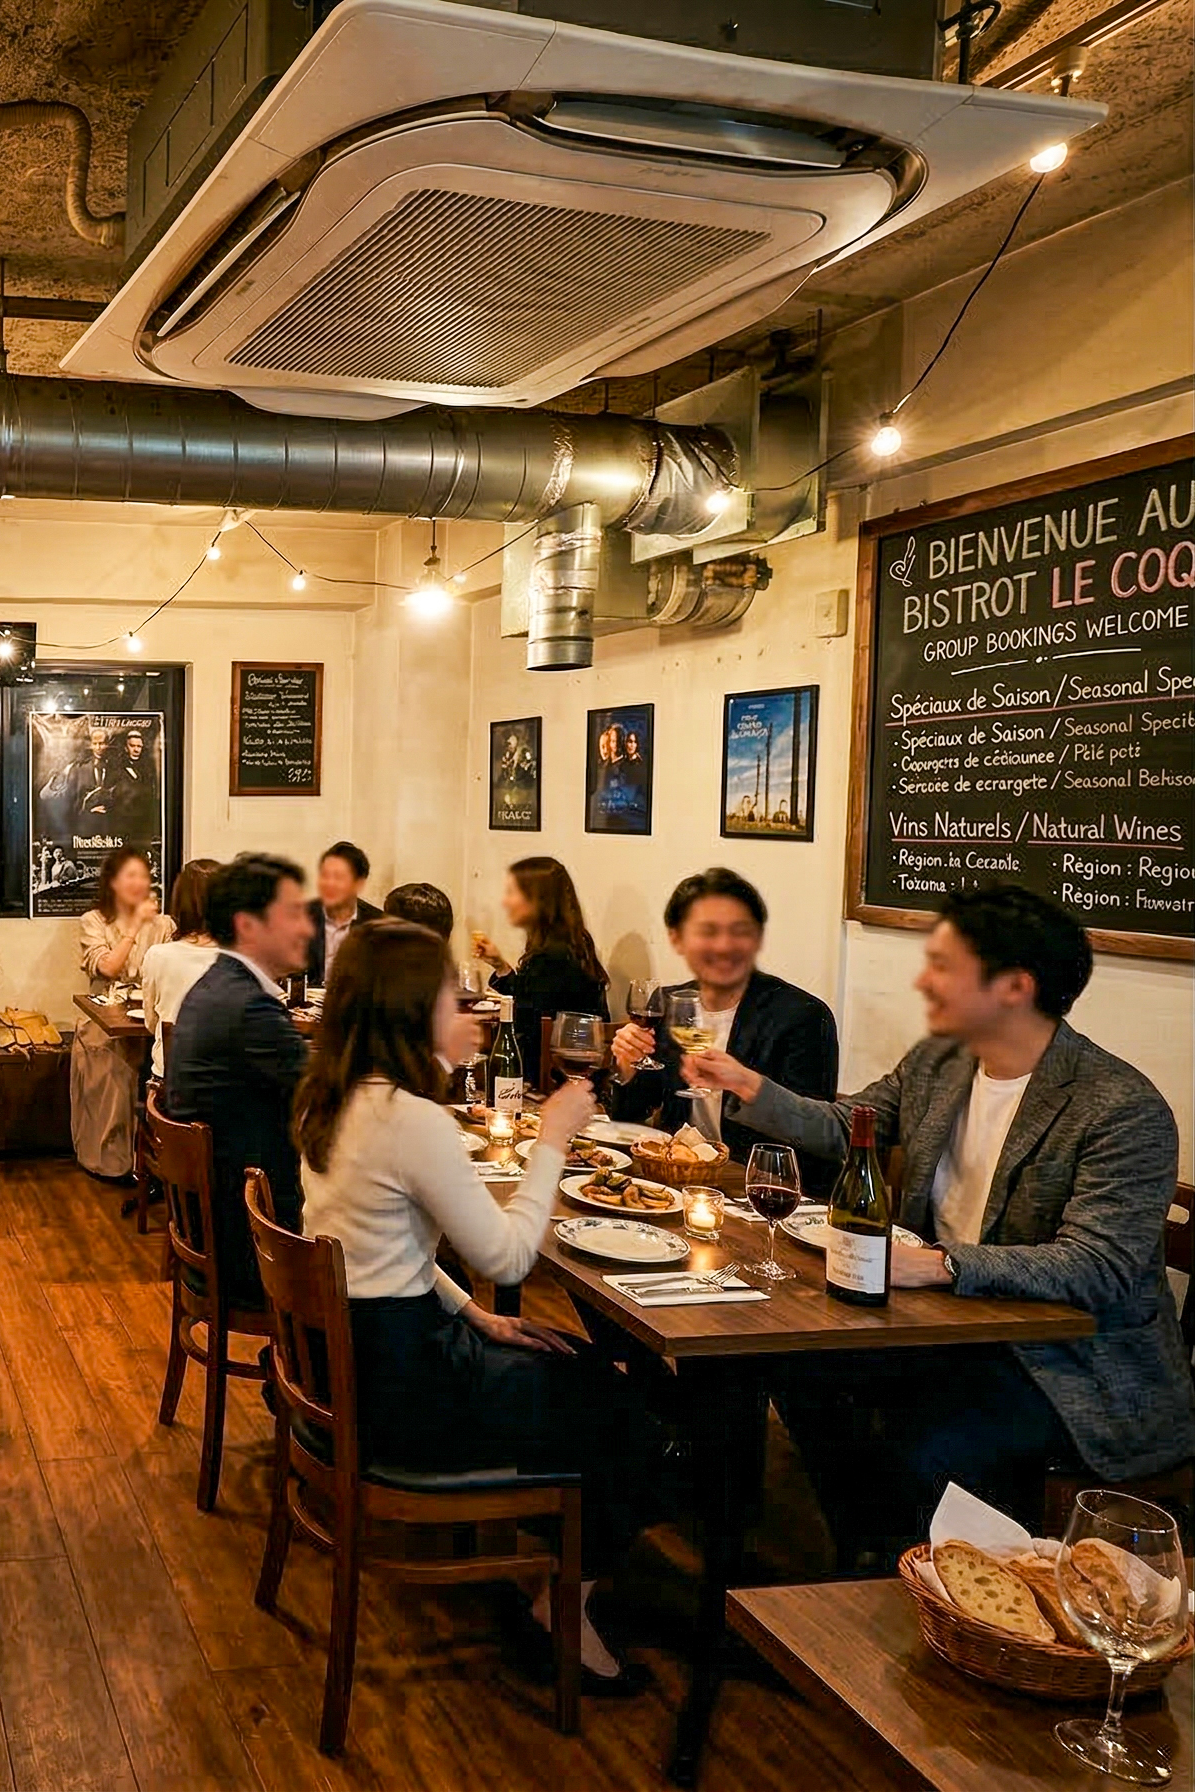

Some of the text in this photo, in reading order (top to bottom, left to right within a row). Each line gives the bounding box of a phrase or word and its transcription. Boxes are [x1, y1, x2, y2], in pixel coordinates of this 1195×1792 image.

[929, 480, 1195, 580] BIENVENUE AU
[903, 541, 1195, 634] BISTROT LE COQ
[923, 605, 1190, 663] GROUP BOOKINGS WELCOME
[890, 693, 962, 726] Spéciaux
[966, 687, 987, 711] de
[1157, 666, 1195, 699] Spe
[901, 729, 963, 757] Spéciaux
[967, 725, 987, 745] de
[991, 721, 1045, 743] Saison
[1064, 713, 1133, 736] Seasonal
[963, 751, 979, 768] de
[954, 774, 972, 793] de
[1063, 768, 1132, 790] Seasonal
[889, 811, 929, 837] Vins
[934, 811, 1012, 839] Naturels
[1032, 811, 1106, 840] Natural
[1113, 813, 1183, 842] Wines
